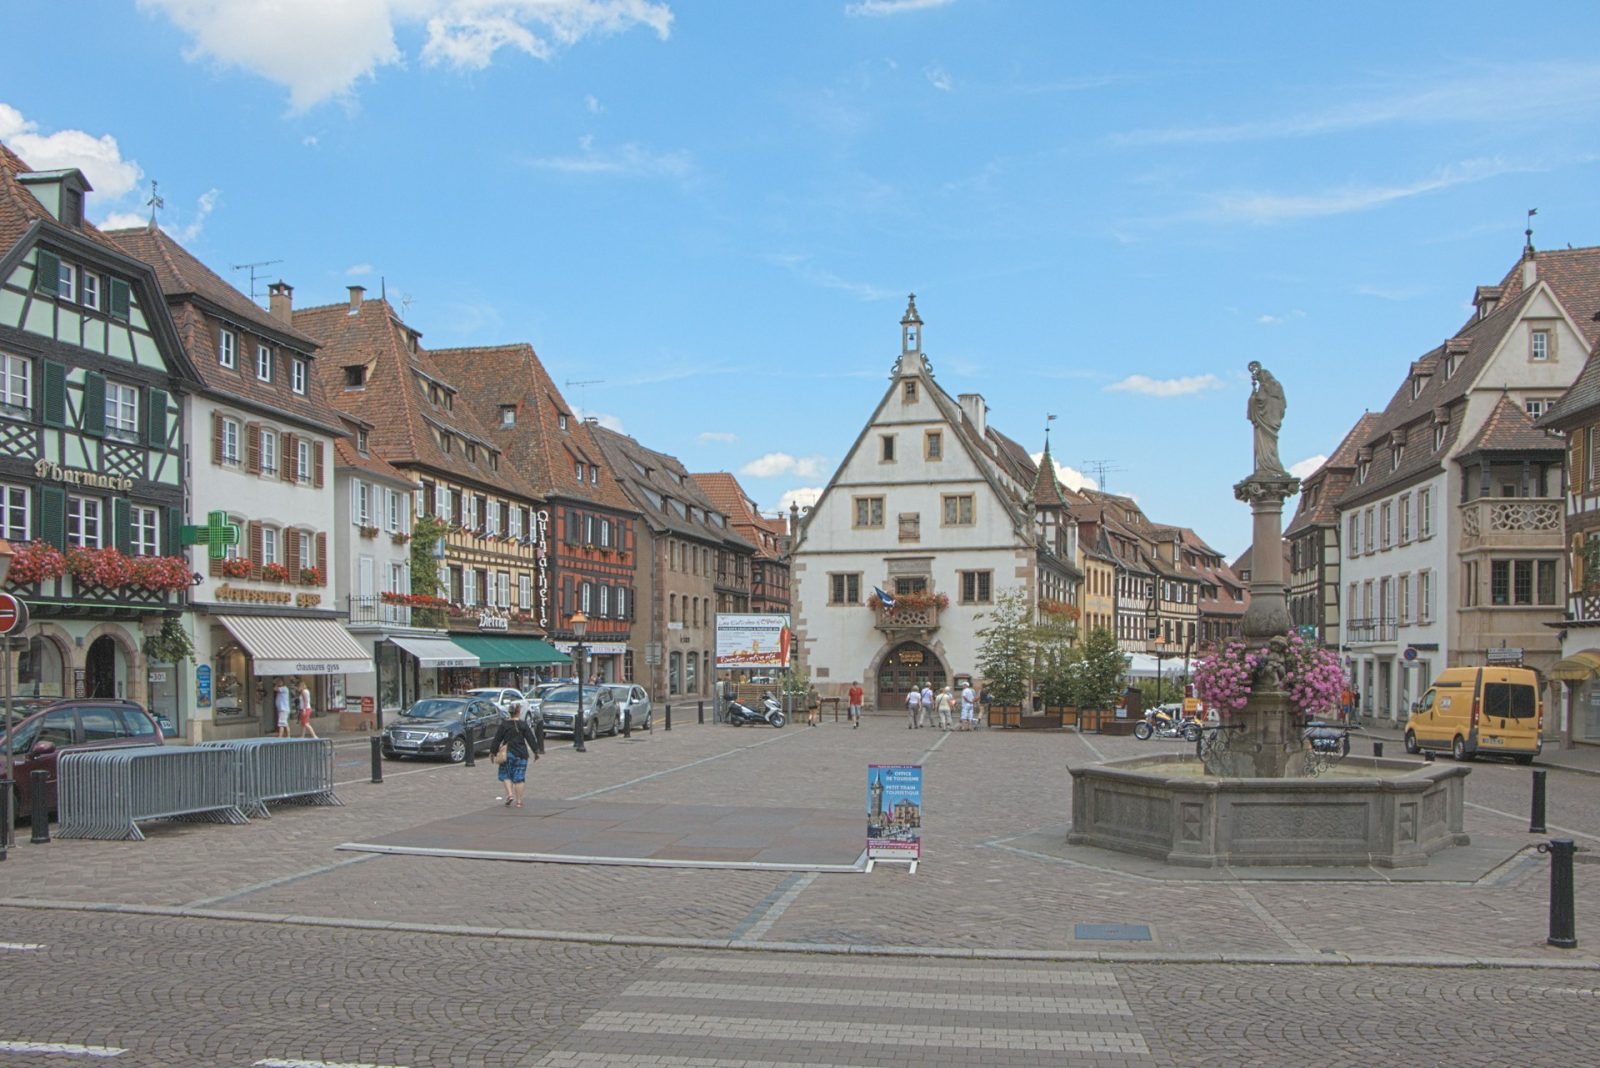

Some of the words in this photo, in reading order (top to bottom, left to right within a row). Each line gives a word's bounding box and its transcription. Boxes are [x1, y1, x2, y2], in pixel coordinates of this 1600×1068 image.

[34, 458, 134, 491] Pharmacie
[537, 510, 548, 627] Quinaillerie
[296, 663, 325, 671] chaussures
[327, 663, 340, 672] gyss
